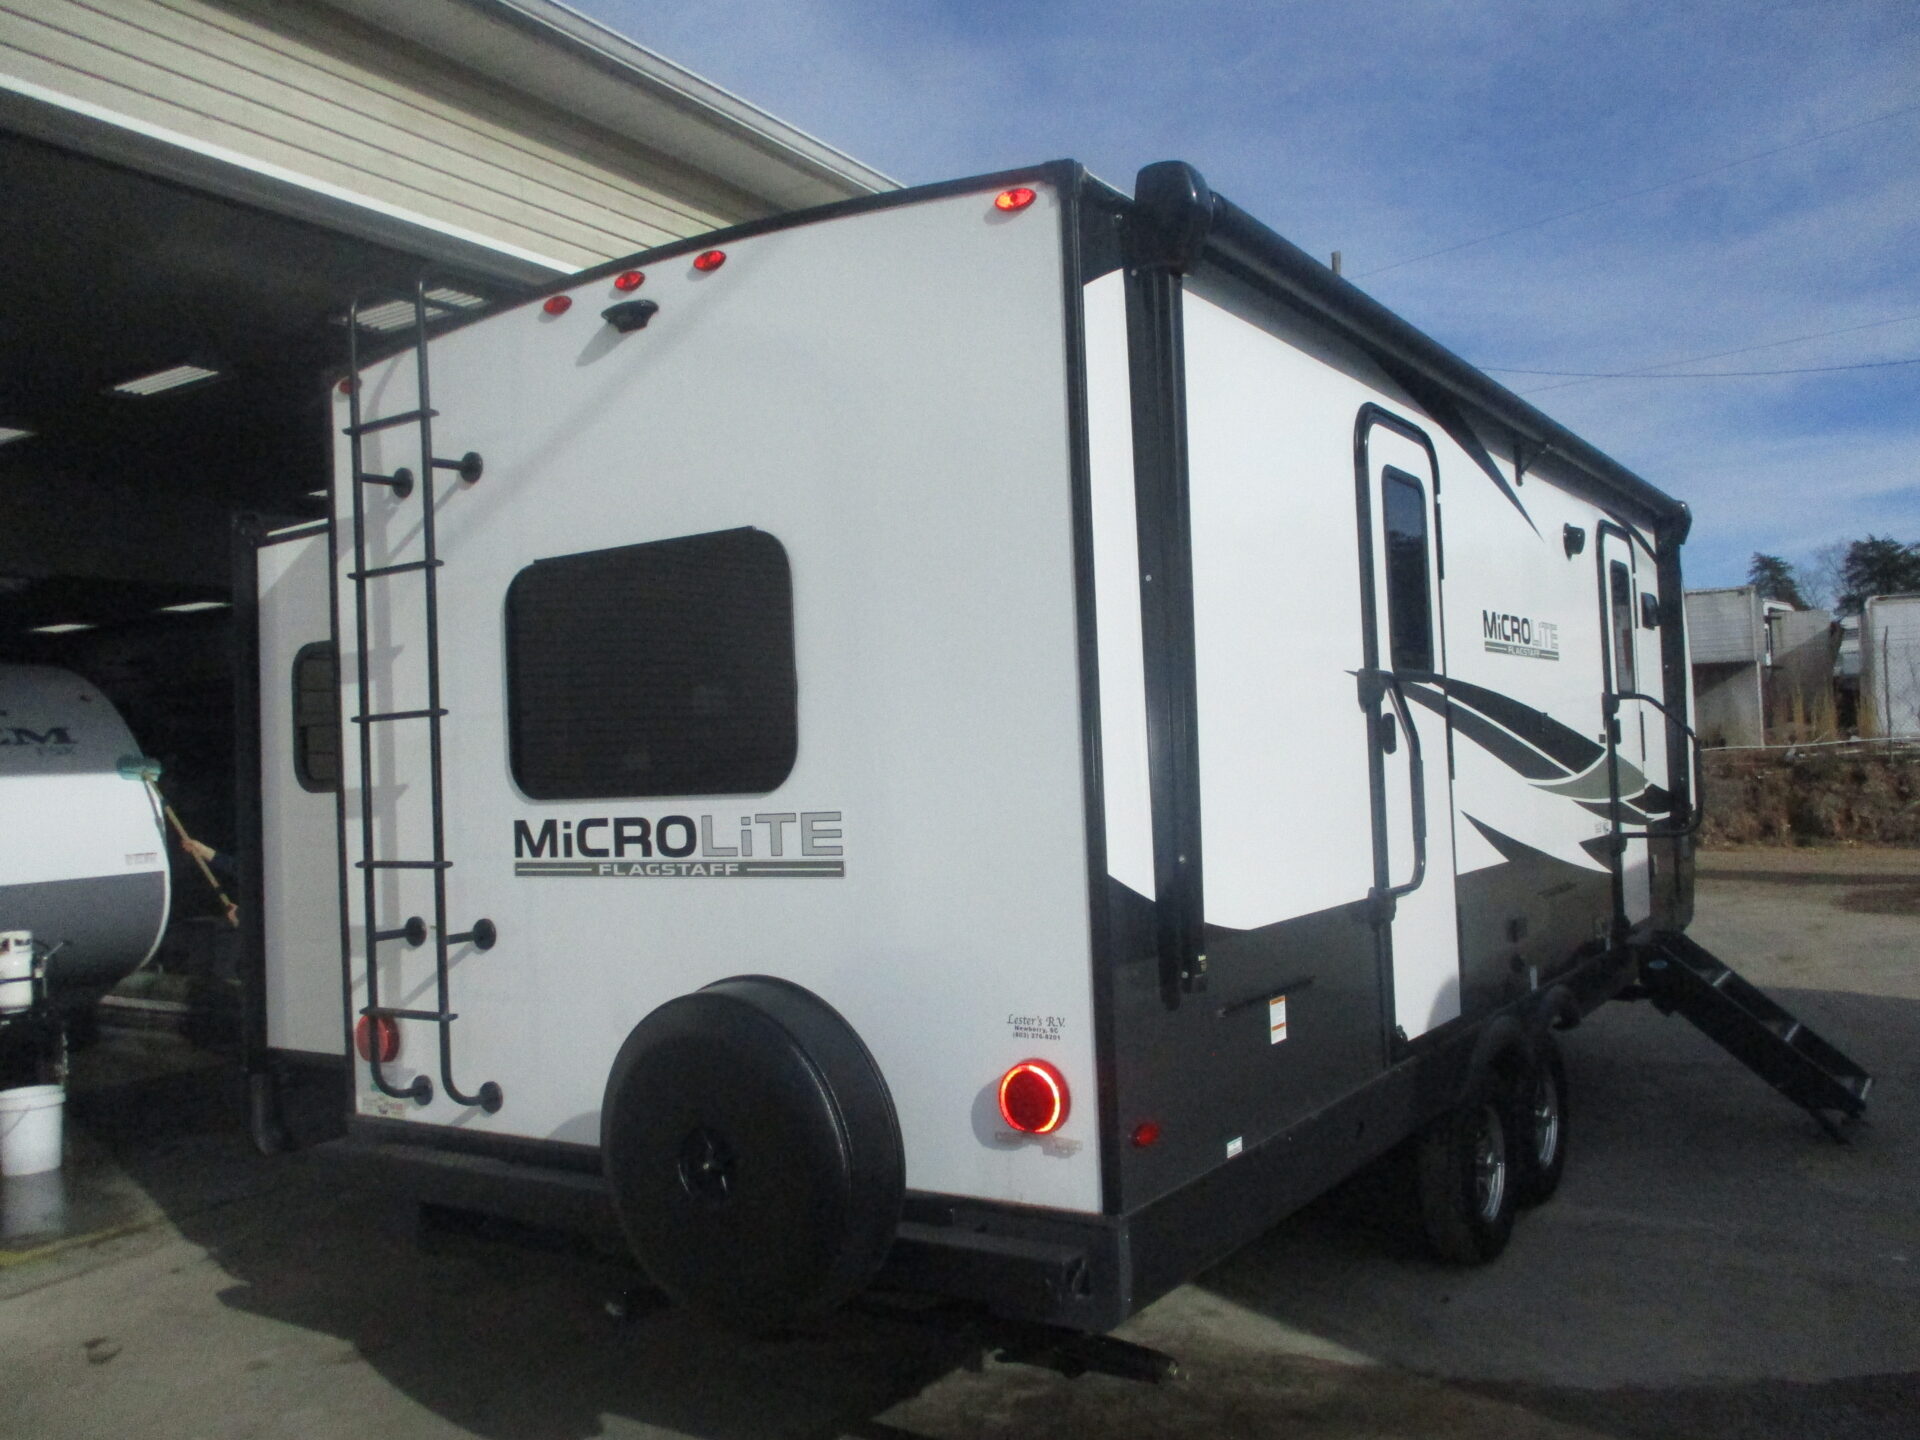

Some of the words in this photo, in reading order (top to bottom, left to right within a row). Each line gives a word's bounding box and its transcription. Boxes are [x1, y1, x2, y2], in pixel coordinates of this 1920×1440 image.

[1507, 646, 1541, 658] FLAGSTAFF
[598, 863, 740, 876] FLAGSTAFF
[1007, 1014, 1043, 1026] Lester's
